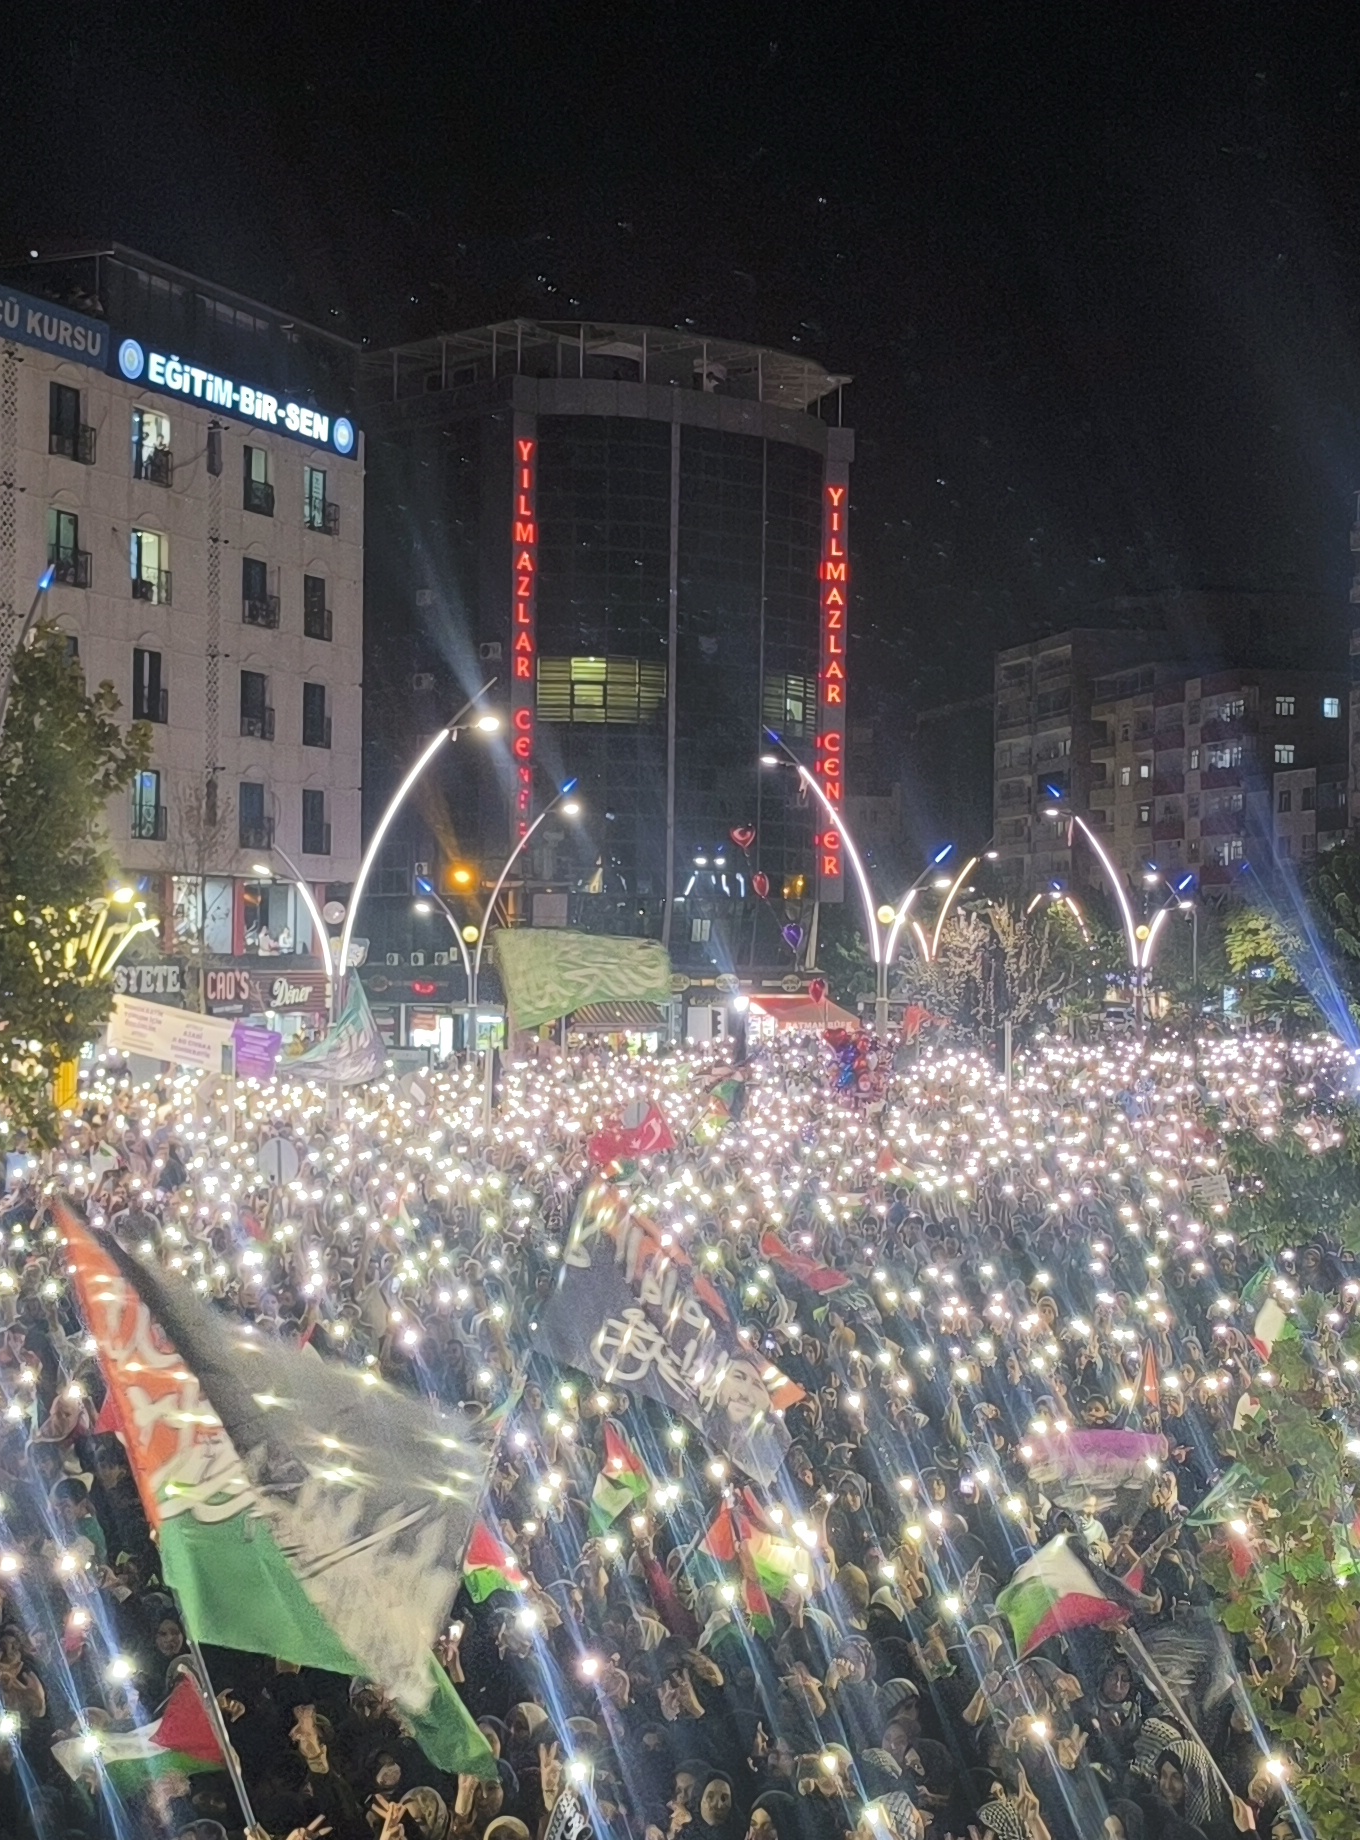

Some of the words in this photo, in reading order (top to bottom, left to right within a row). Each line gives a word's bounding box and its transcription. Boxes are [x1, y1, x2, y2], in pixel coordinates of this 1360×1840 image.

[26, 310, 103, 358] KURSU
[515, 440, 536, 678] YILMAZLAR
[825, 487, 847, 703] YILMAZLAR
